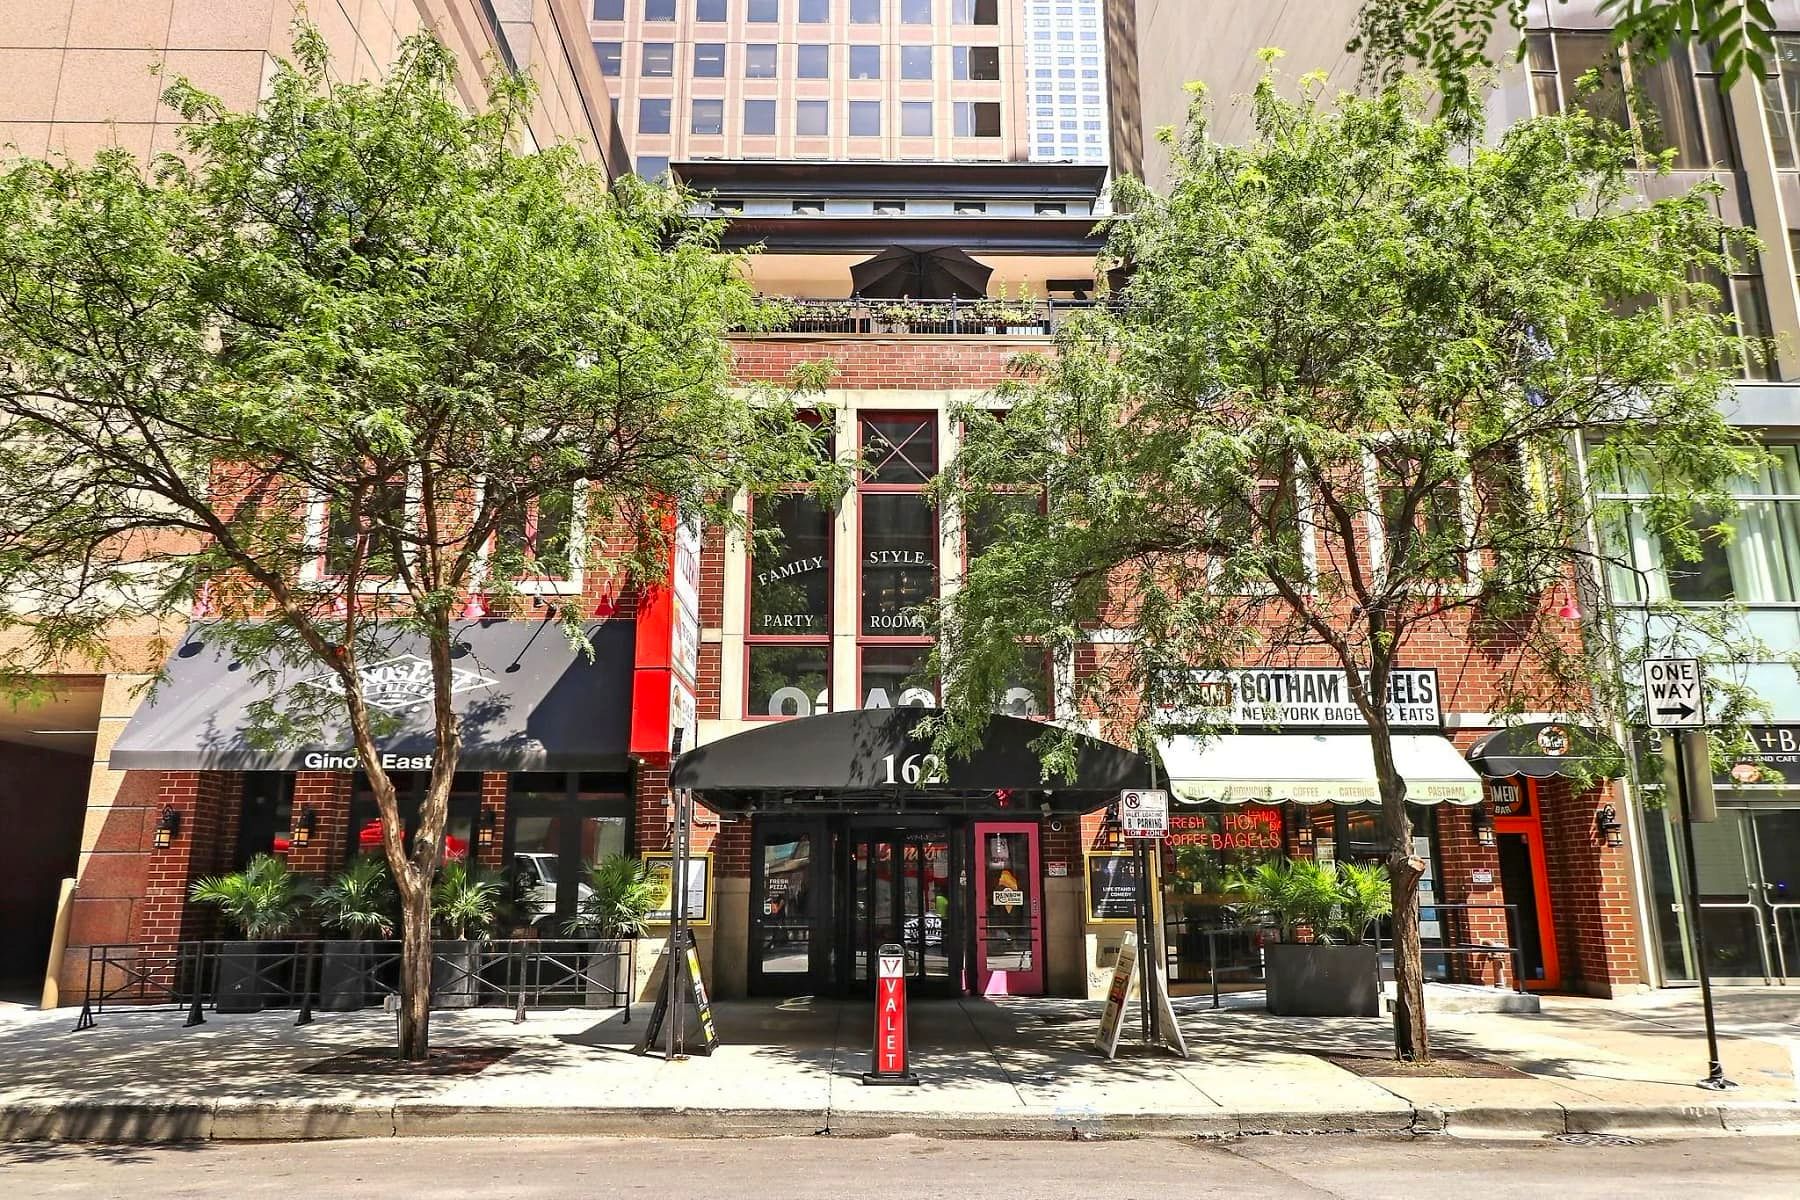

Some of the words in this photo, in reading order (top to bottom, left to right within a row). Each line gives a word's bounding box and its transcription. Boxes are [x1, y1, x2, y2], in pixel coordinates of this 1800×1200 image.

[757, 555, 824, 586] FAMILY
[869, 550, 925, 564] STYLE
[763, 614, 815, 627] PARTY
[1651, 664, 1693, 680] ONE
[1240, 673, 1339, 703] GOTHAM
[1651, 683, 1695, 699] WAY
[1242, 707, 1276, 720] NEW
[1281, 707, 1320, 720] YORK
[1325, 707, 1366, 720] BAGE
[1400, 707, 1434, 720] EATS
[304, 752, 365, 769] Gino'
[382, 753, 433, 769] East
[882, 753, 941, 785] 162
[1293, 786, 1320, 797] COFFEE
[1339, 786, 1376, 797] CATERING
[1428, 786, 1466, 797] PASTRAMI
[1494, 805, 1512, 814] BAR
[1137, 818, 1163, 829] PARKING
[1168, 816, 1205, 829] FRESH
[1225, 815, 1260, 830] HOT
[1165, 834, 1208, 846] COFFEE
[1211, 832, 1281, 850] BAGELS
[885, 979, 897, 1069] VALET
